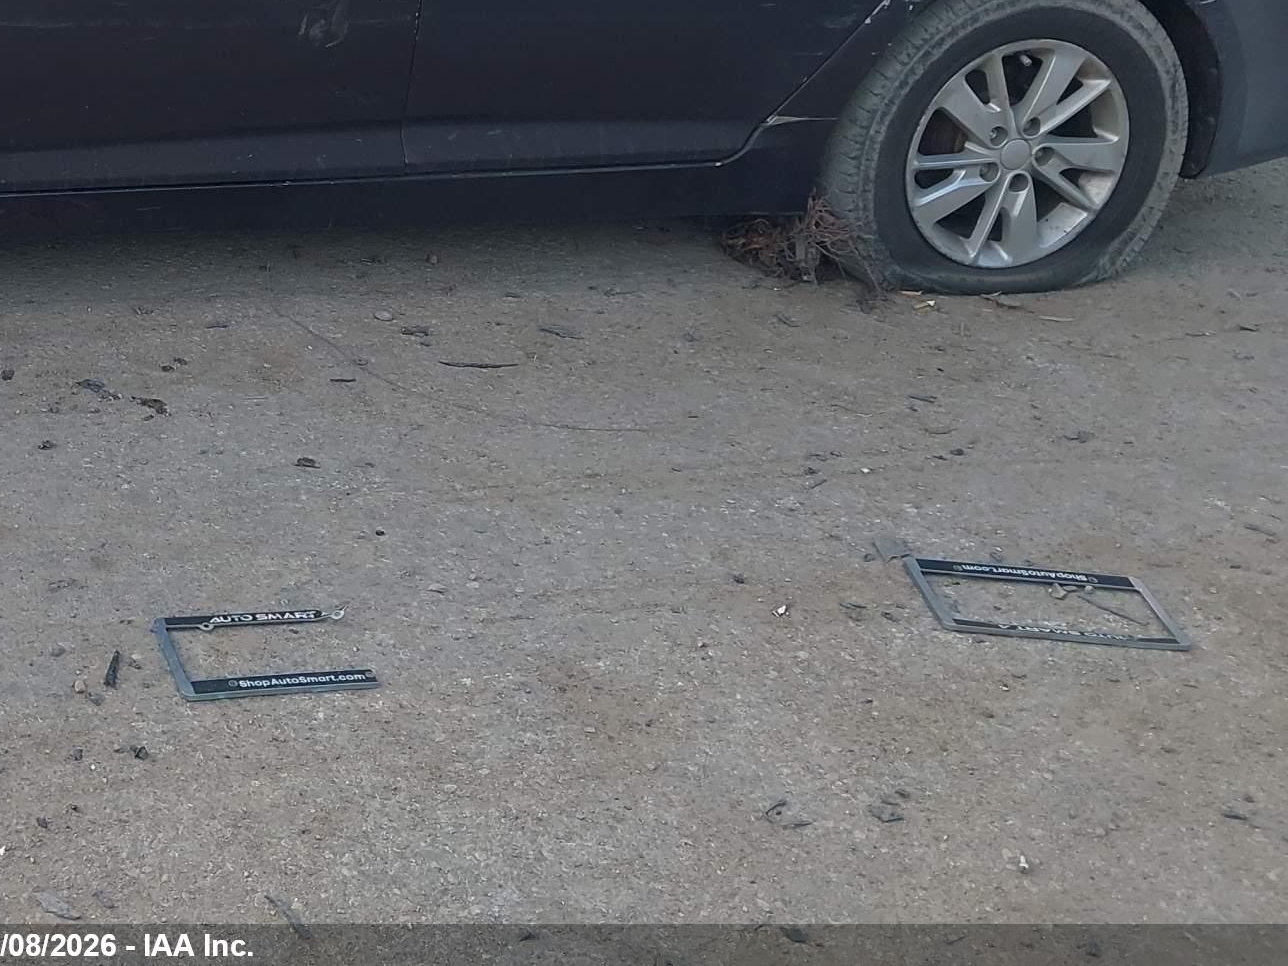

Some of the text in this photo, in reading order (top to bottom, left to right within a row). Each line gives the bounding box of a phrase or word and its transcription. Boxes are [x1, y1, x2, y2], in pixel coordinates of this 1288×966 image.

[962, 564, 1088, 581] ShopAutoSmart.com
[209, 610, 317, 623] AUTO SMART
[238, 672, 366, 688] ShopAutoSmart.com
